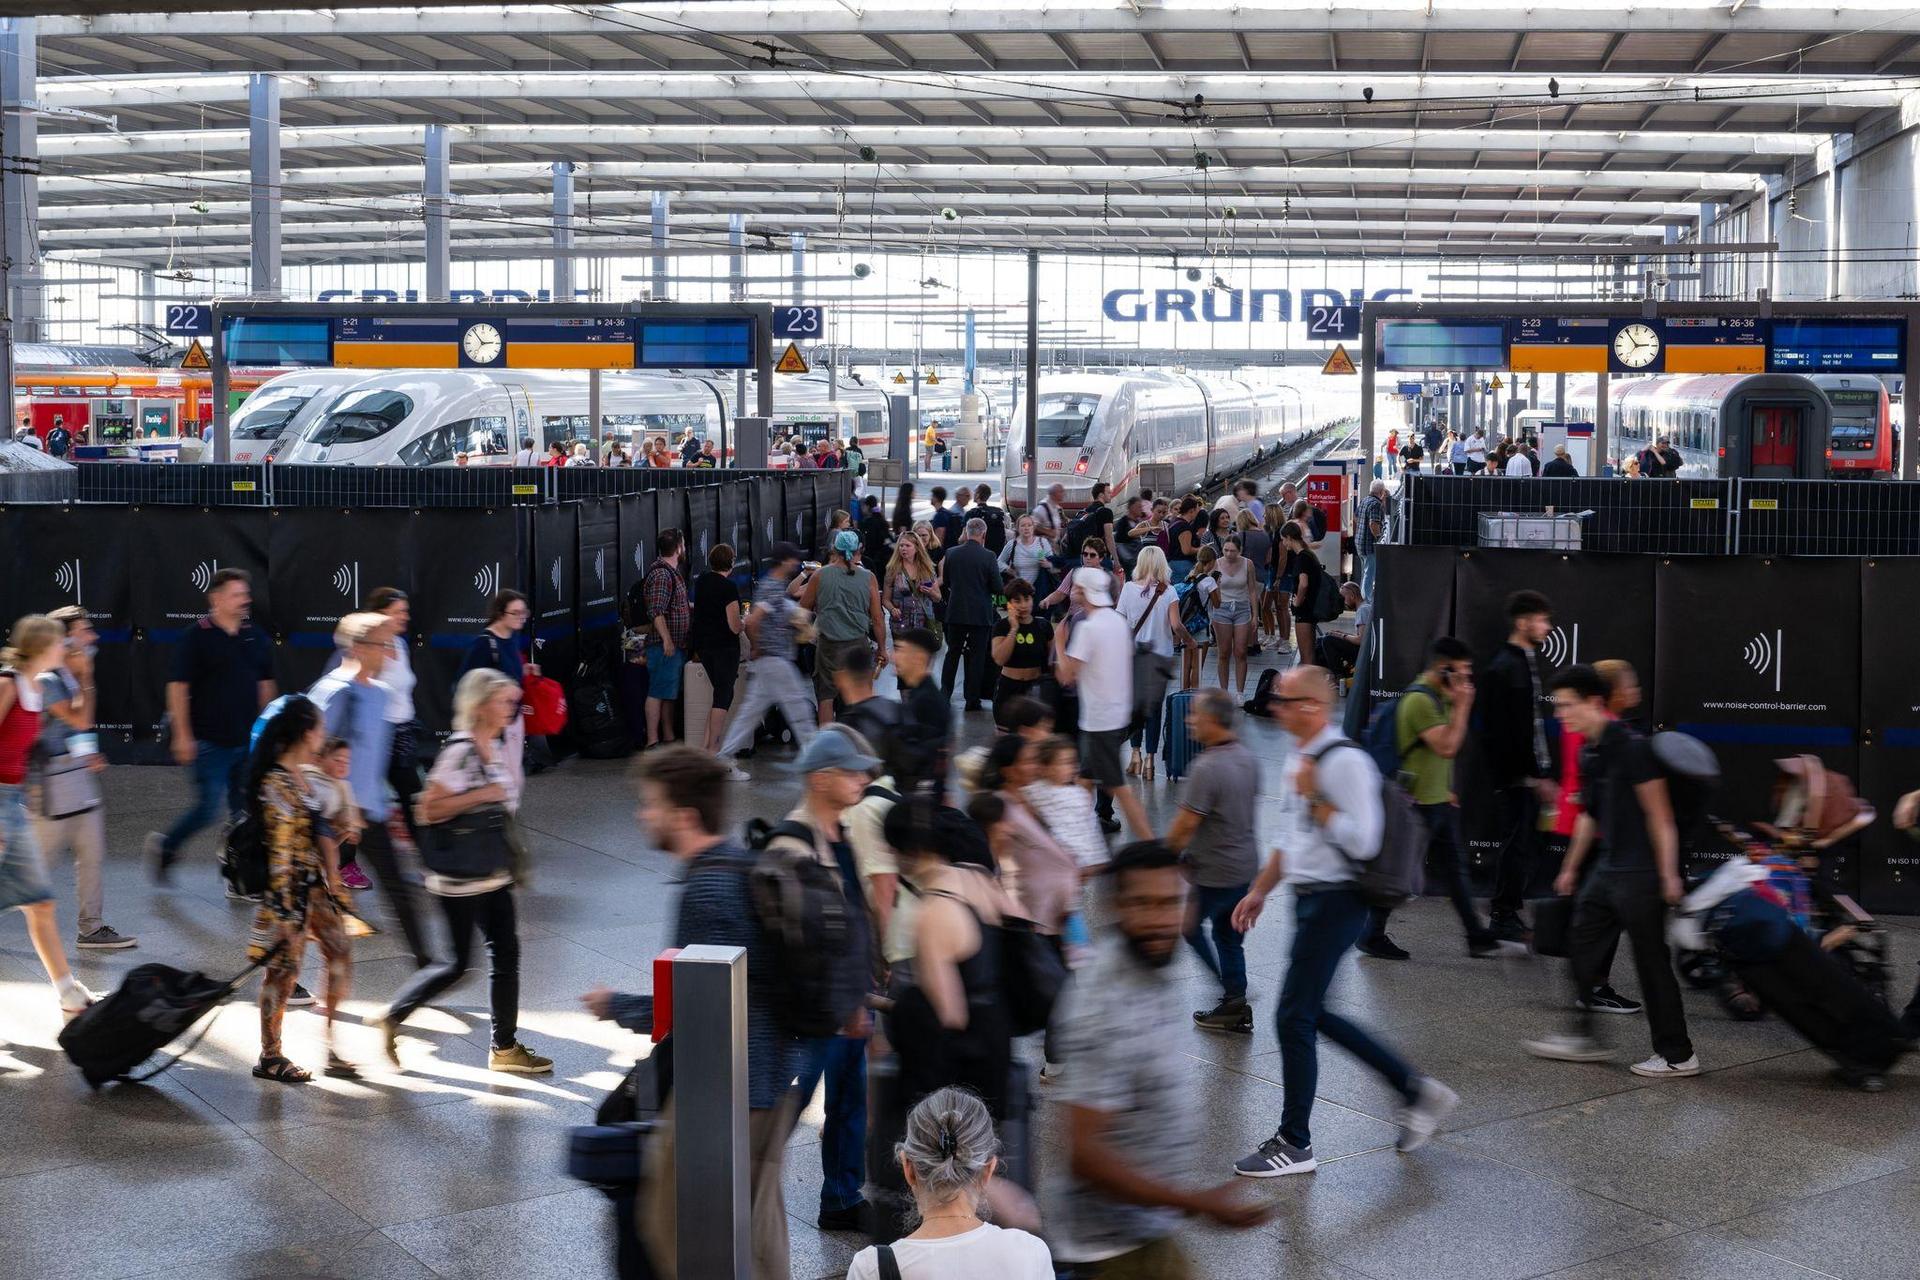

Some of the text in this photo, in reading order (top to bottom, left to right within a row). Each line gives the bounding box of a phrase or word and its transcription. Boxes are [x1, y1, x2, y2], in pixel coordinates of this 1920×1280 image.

[170, 306, 198, 330] 22
[343, 318, 358, 326] 5-21
[604, 318, 625, 327] 24-36
[786, 307, 818, 332] 23
[1311, 307, 1345, 333] 24
[1521, 318, 1541, 327] 5-23
[1729, 319, 1755, 327] 26-36
[1434, 387, 1440, 395] B
[1452, 383, 1461, 393] A
[1046, 461, 1061, 470] DB
[1703, 701, 1827, 711] www.noise-control-barrier.com
